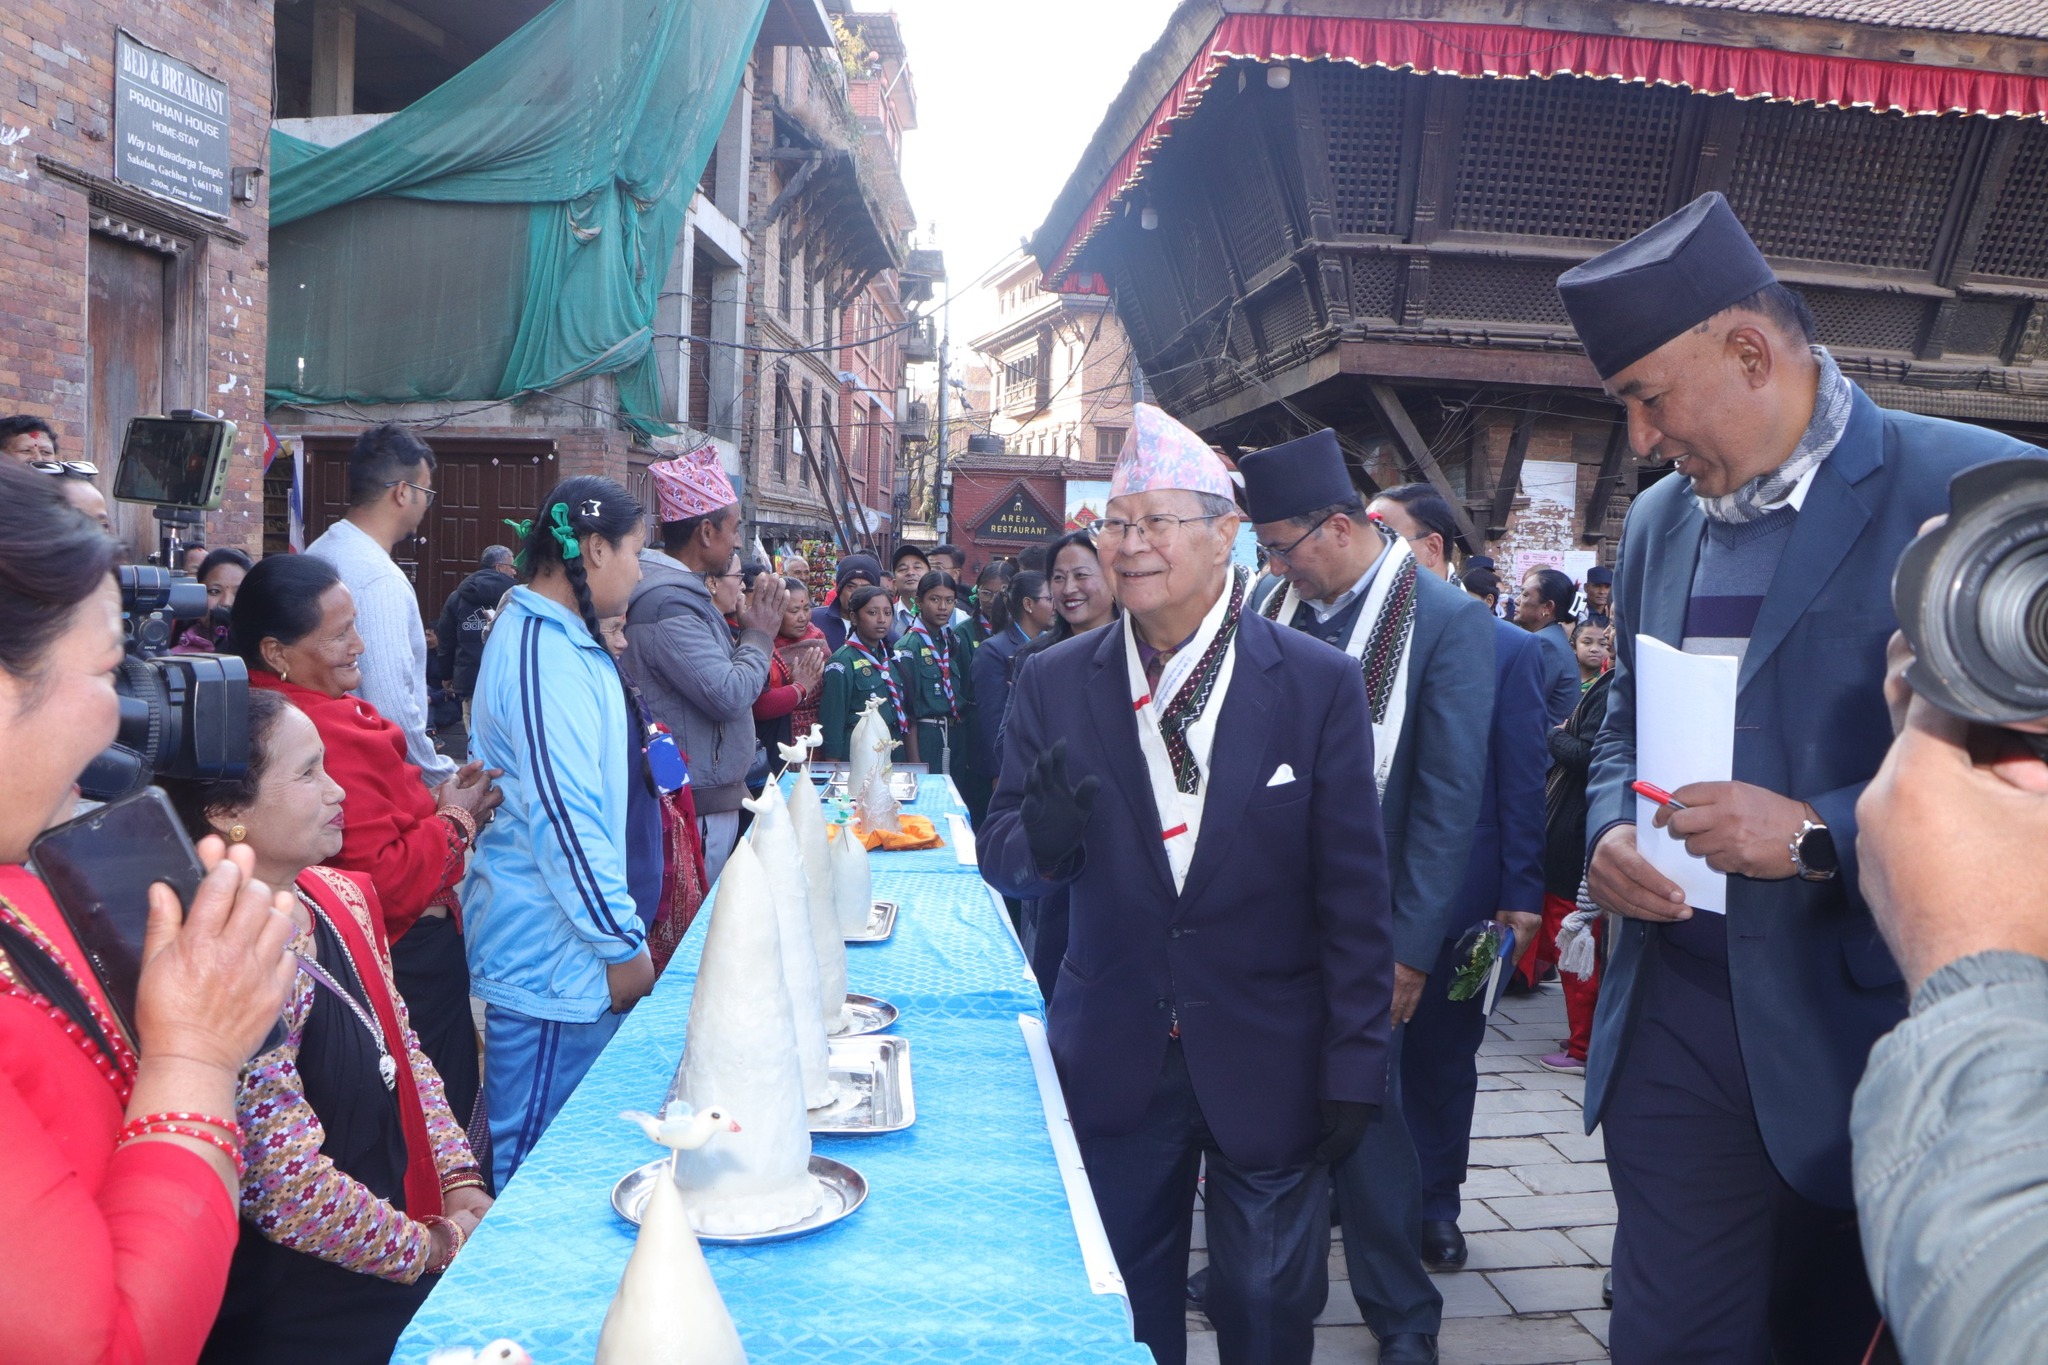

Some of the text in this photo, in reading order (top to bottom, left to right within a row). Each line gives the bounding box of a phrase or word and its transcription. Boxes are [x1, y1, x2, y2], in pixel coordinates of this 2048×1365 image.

[123, 43, 224, 116] BED & BREAKFAST
[129, 88, 220, 139] PRADHAN HOUSE
[152, 121, 200, 148] HOME-STAY
[127, 132, 224, 180] Way to Navadurga Temple
[158, 164, 188, 184] Gachhen
[197, 179, 224, 196] 6611785
[170, 185, 188, 198] from
[188, 191, 203, 203] here
[991, 525, 1048, 535] RESTAURANT
[1001, 514, 1035, 523] ARENA
